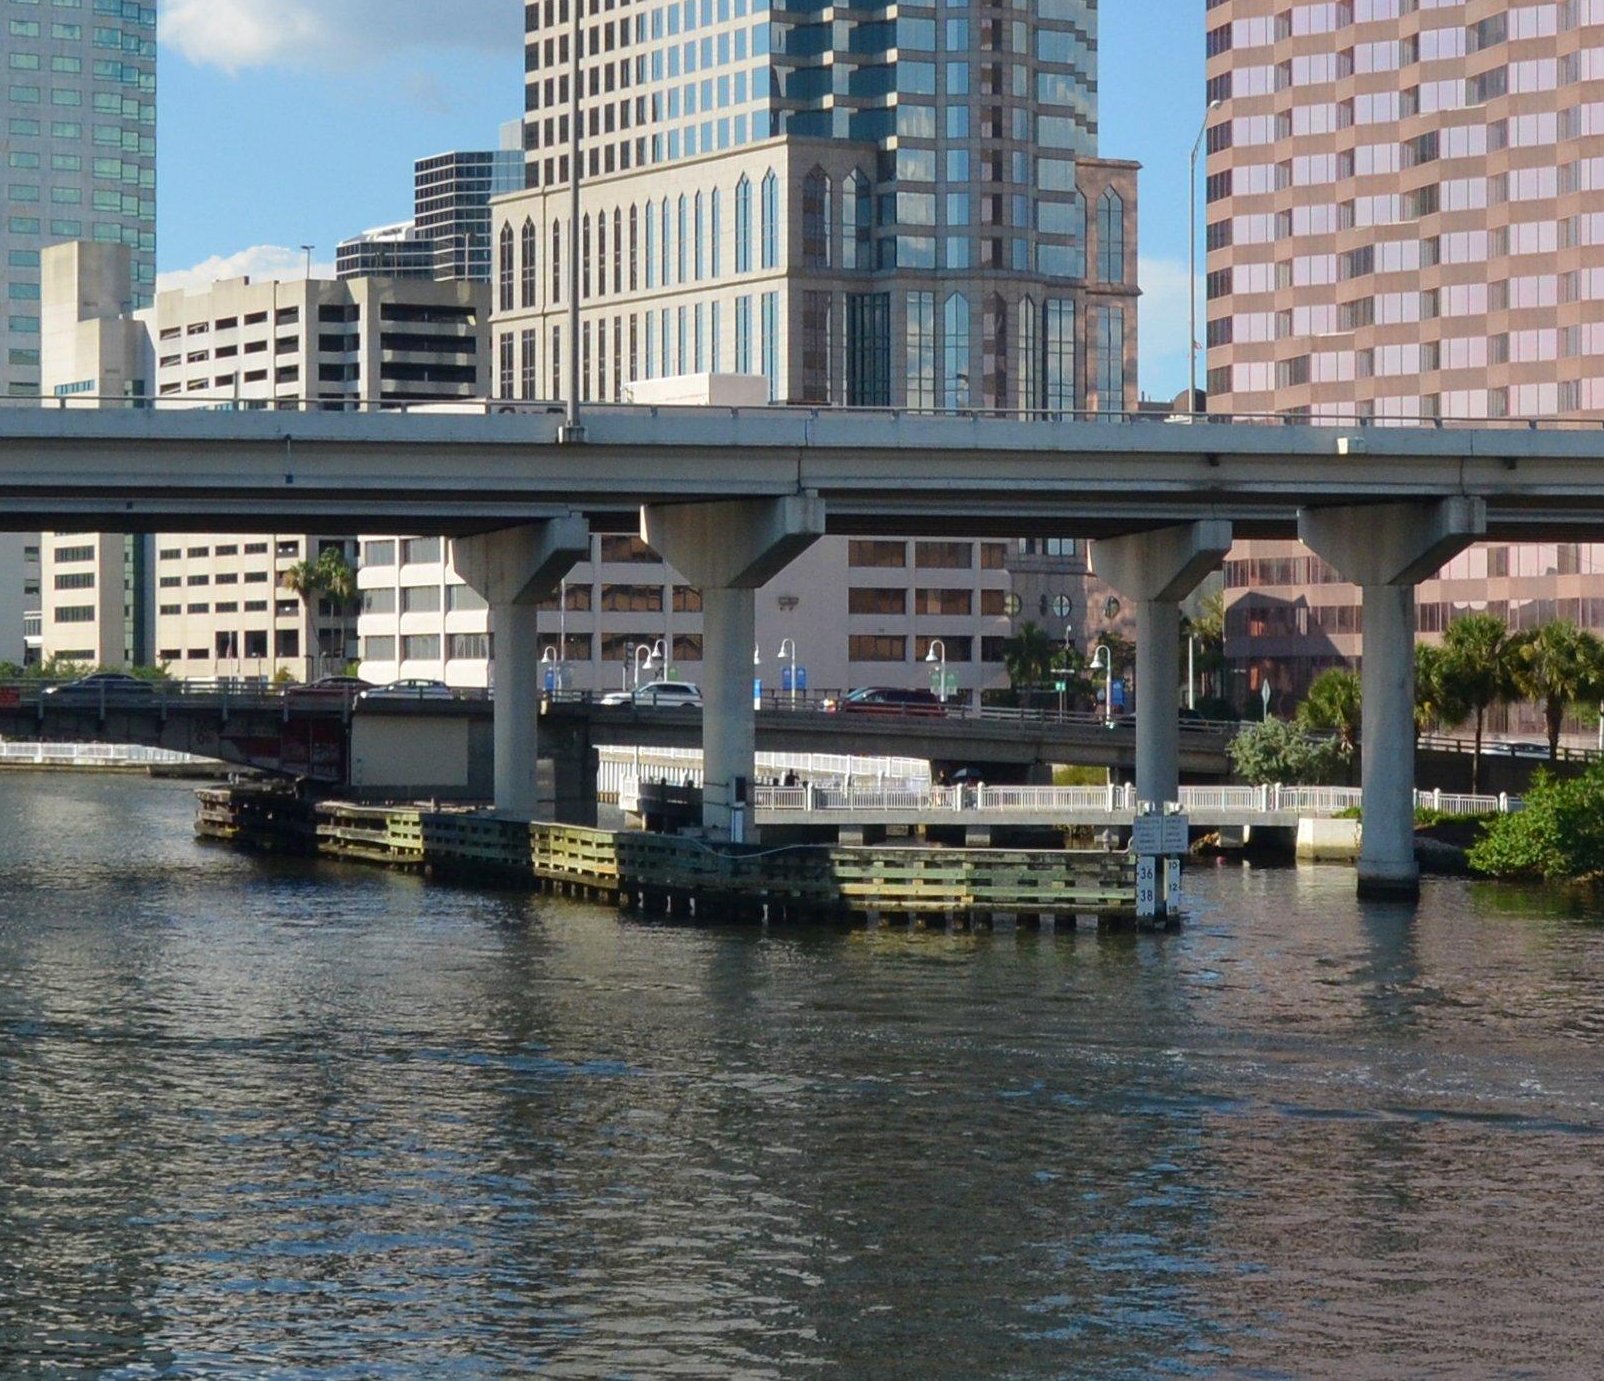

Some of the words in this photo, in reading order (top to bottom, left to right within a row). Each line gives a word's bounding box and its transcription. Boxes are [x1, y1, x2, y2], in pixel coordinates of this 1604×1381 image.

[1168, 861, 1178, 869] 10
[1140, 868, 1153, 879] 36
[1168, 883, 1178, 891] 12
[1140, 890, 1153, 902] 38
